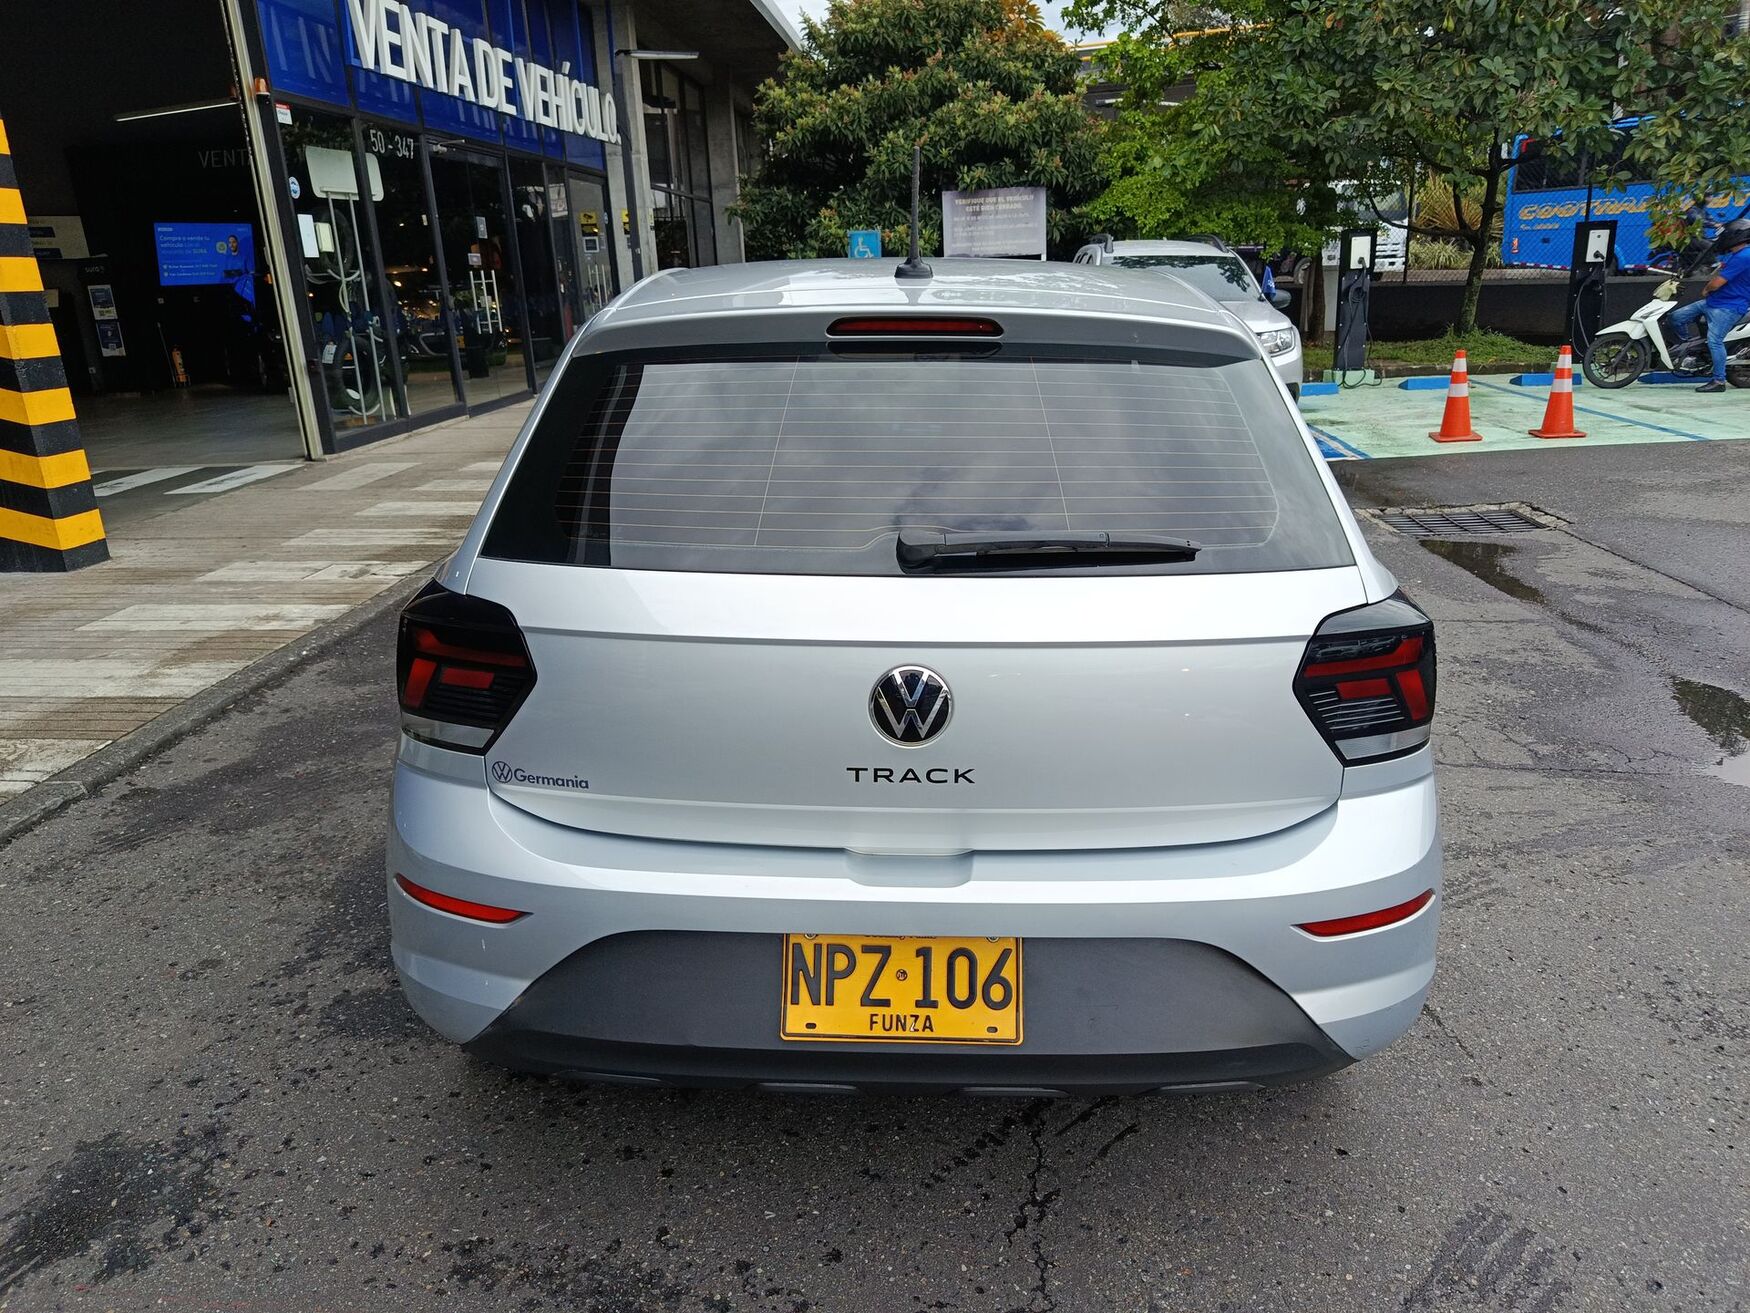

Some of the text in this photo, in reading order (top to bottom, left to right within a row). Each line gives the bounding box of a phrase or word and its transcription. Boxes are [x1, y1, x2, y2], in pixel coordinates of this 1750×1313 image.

[348, 0, 475, 102] VENTA
[473, 38, 517, 115] DE
[369, 129, 386, 153] 50
[395, 135, 415, 159] 347
[197, 149, 249, 168] VENT
[514, 768, 589, 789] Germania
[846, 767, 975, 784] TRACK
[869, 1013, 934, 1032] FUNZA
